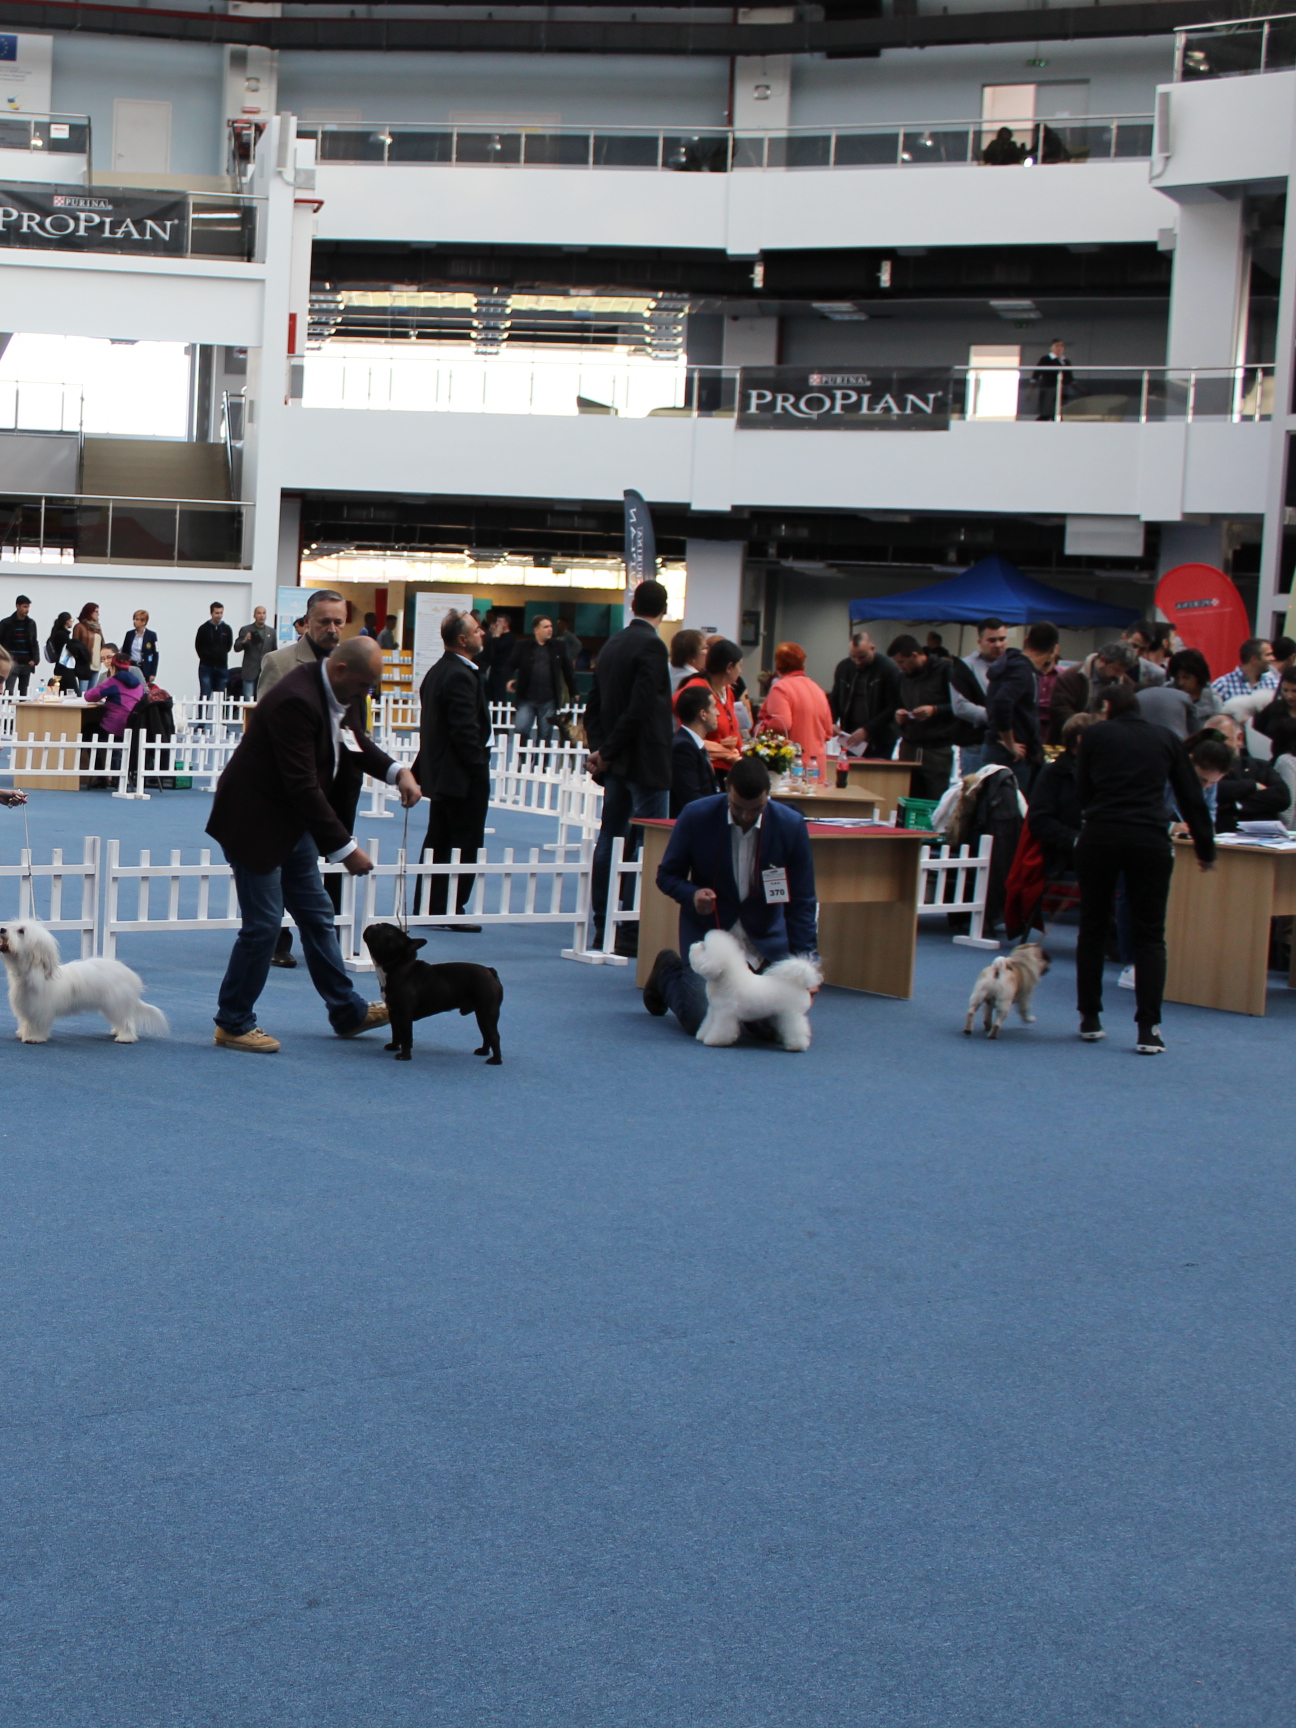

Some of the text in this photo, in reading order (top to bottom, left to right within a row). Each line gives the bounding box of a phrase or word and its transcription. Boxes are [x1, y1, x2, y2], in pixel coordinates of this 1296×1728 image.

[65, 197, 107, 209] PURINA
[821, 375, 865, 386] PURINA
[769, 889, 785, 897] 370
